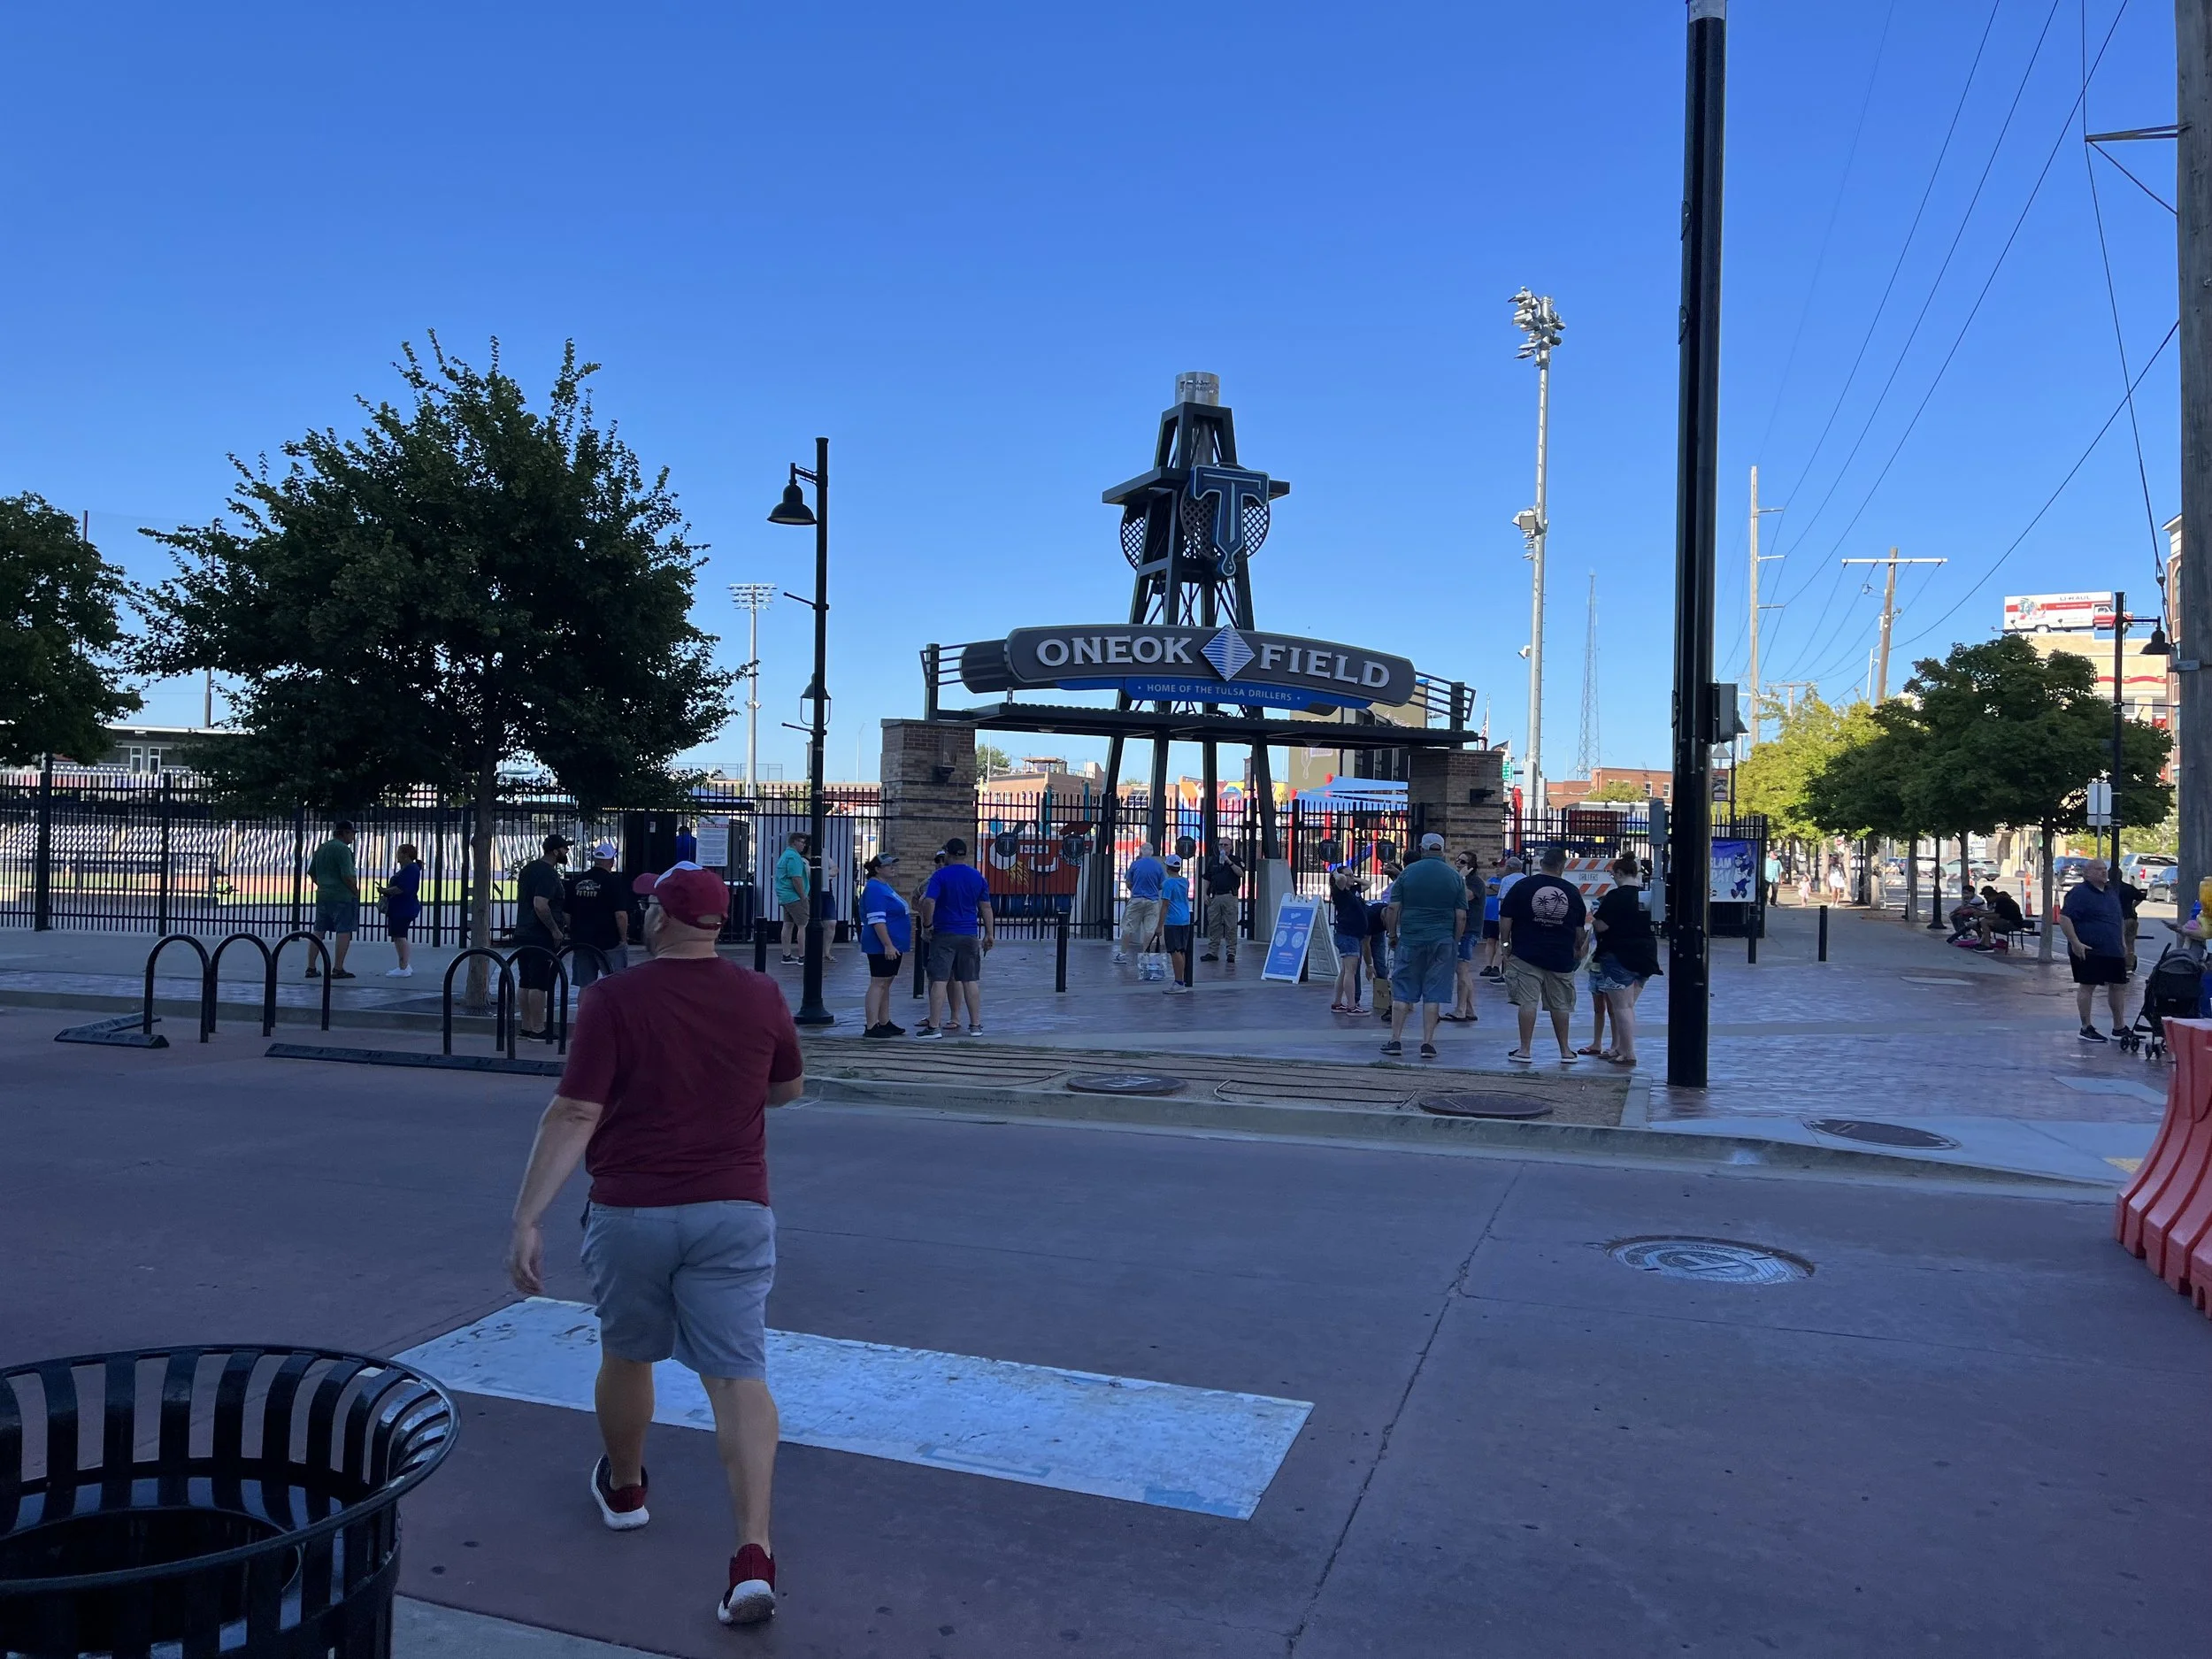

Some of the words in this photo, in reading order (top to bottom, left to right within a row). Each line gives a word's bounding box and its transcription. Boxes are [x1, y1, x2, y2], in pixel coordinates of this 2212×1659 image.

[1036, 635, 1193, 667] ONEOK
[1258, 642, 1390, 688] FIELD
[1147, 684, 1176, 693] HOME
[1179, 684, 1192, 693] OF
[1195, 685, 1213, 695] THE
[1215, 687, 1245, 696] TULSA
[1248, 688, 1292, 701] DRILLERS
